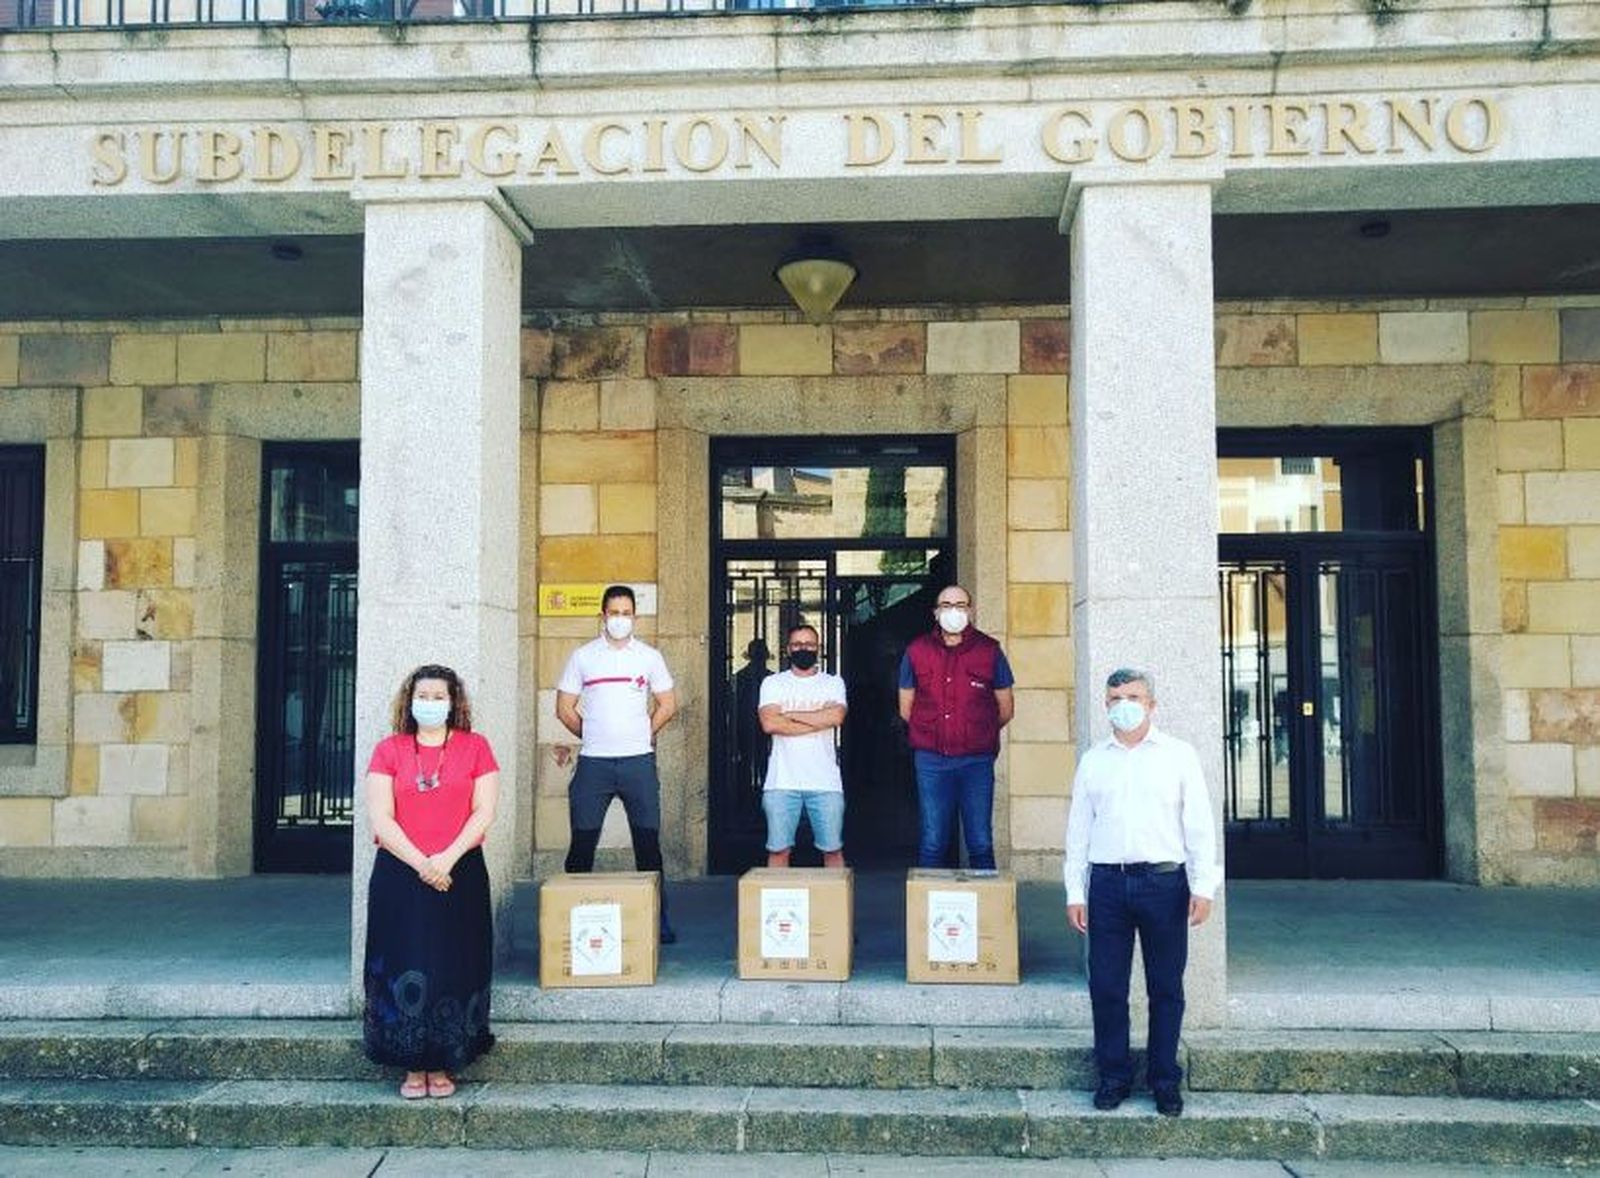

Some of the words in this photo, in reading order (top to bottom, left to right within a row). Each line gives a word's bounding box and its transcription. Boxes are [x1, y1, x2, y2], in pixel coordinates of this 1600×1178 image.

[92, 112, 785, 187] SUBDELEGACION
[843, 109, 1002, 167] DEL
[1041, 97, 1502, 164] GOBIERNO
